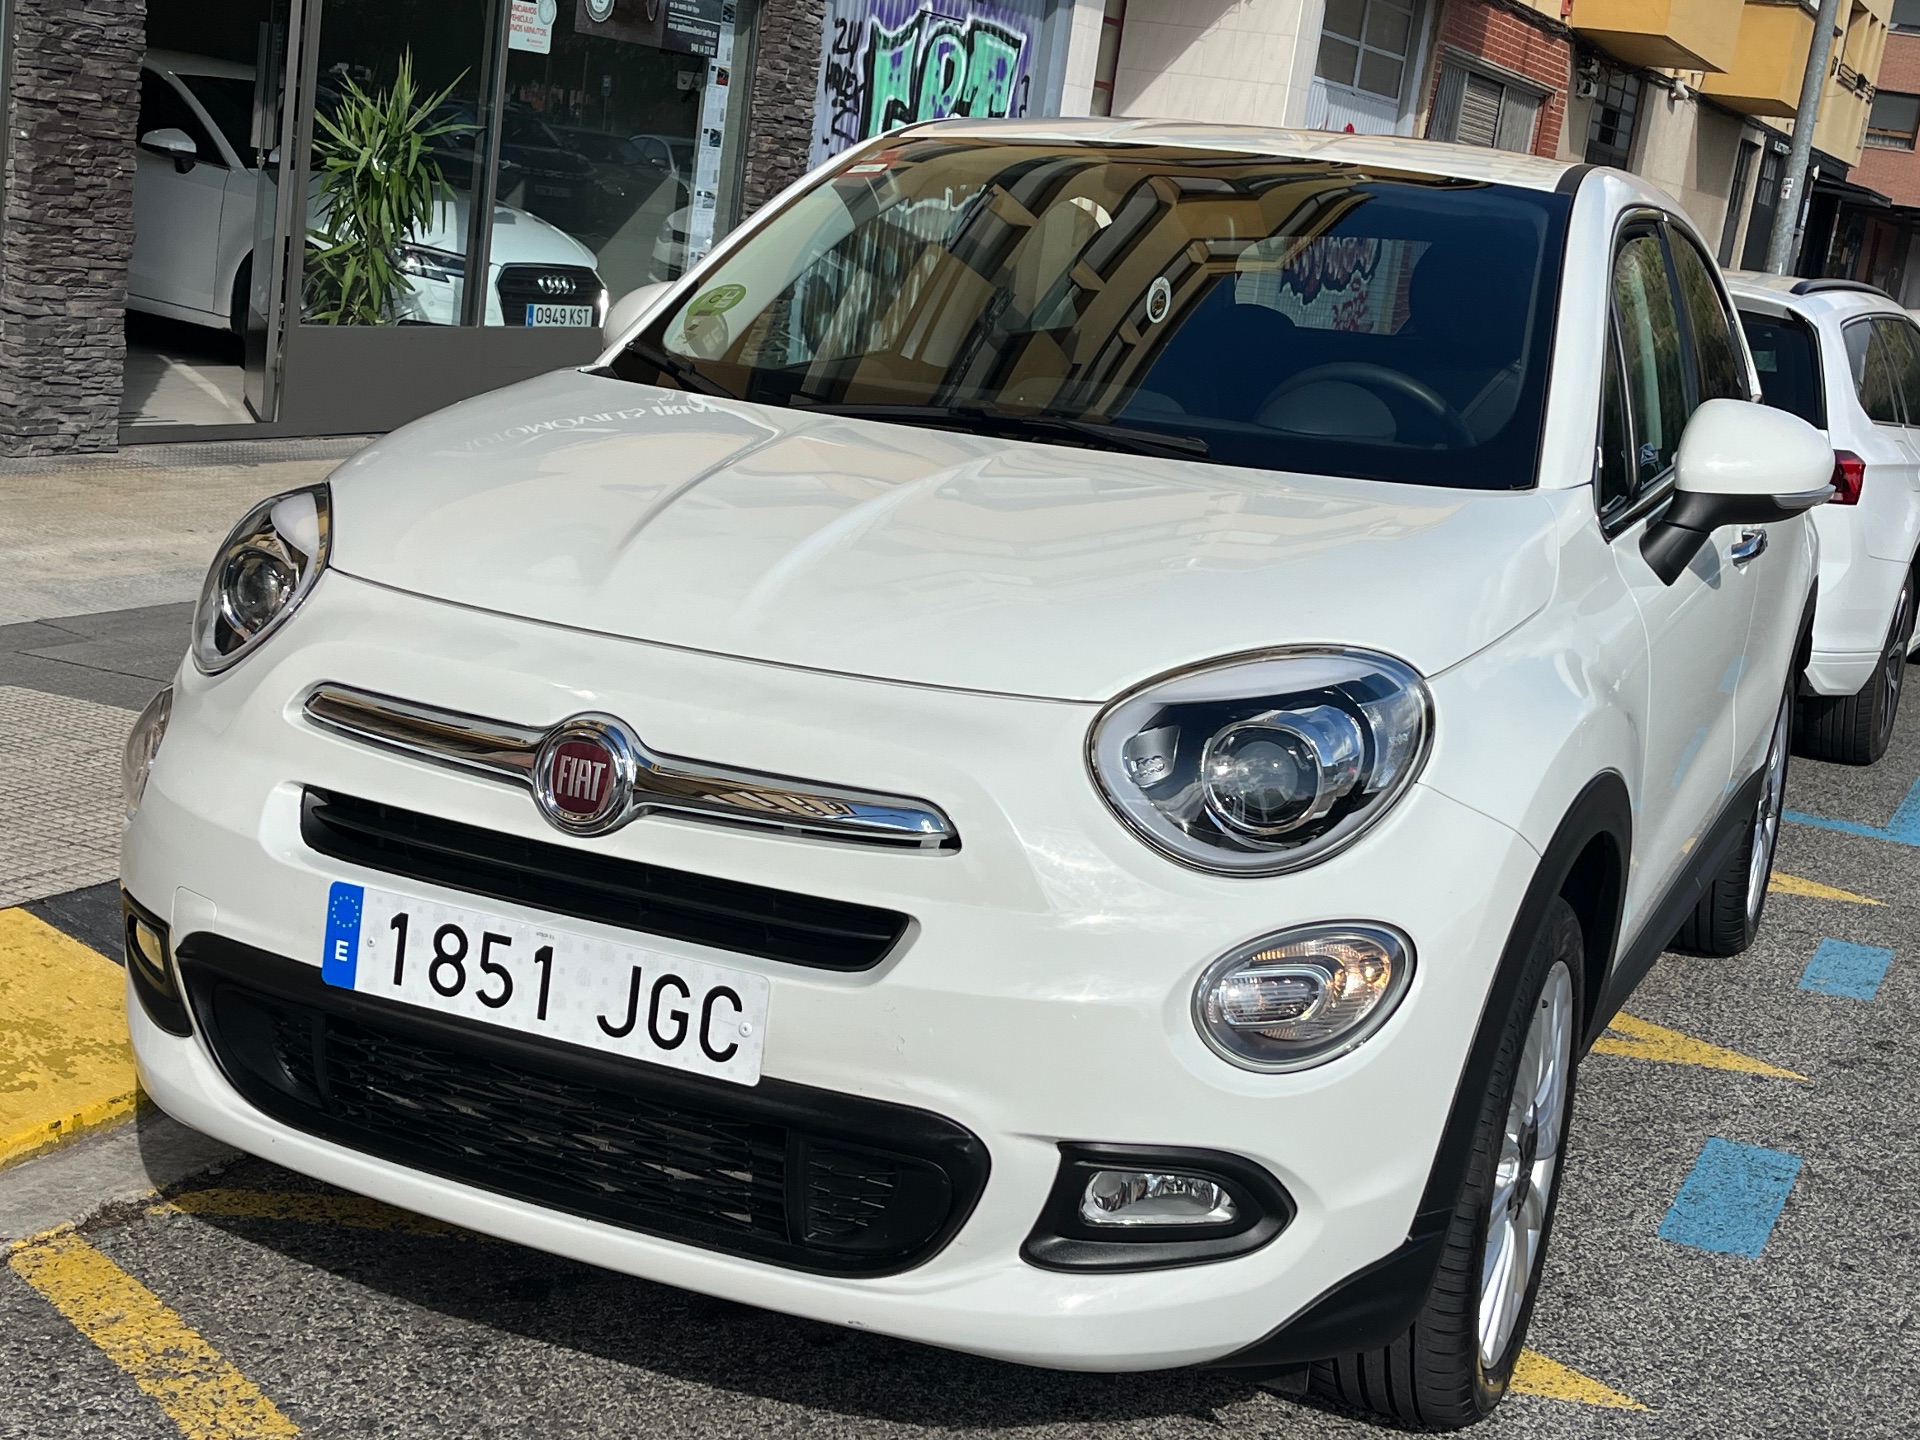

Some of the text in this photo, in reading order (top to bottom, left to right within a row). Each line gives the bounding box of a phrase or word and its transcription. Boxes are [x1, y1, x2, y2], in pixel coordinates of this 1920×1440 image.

[536, 307, 567, 326] 0949
[569, 308, 590, 326] KST
[556, 754, 607, 802] FIAT
[334, 939, 349, 962] E
[390, 911, 743, 1063] 1851 JGC
